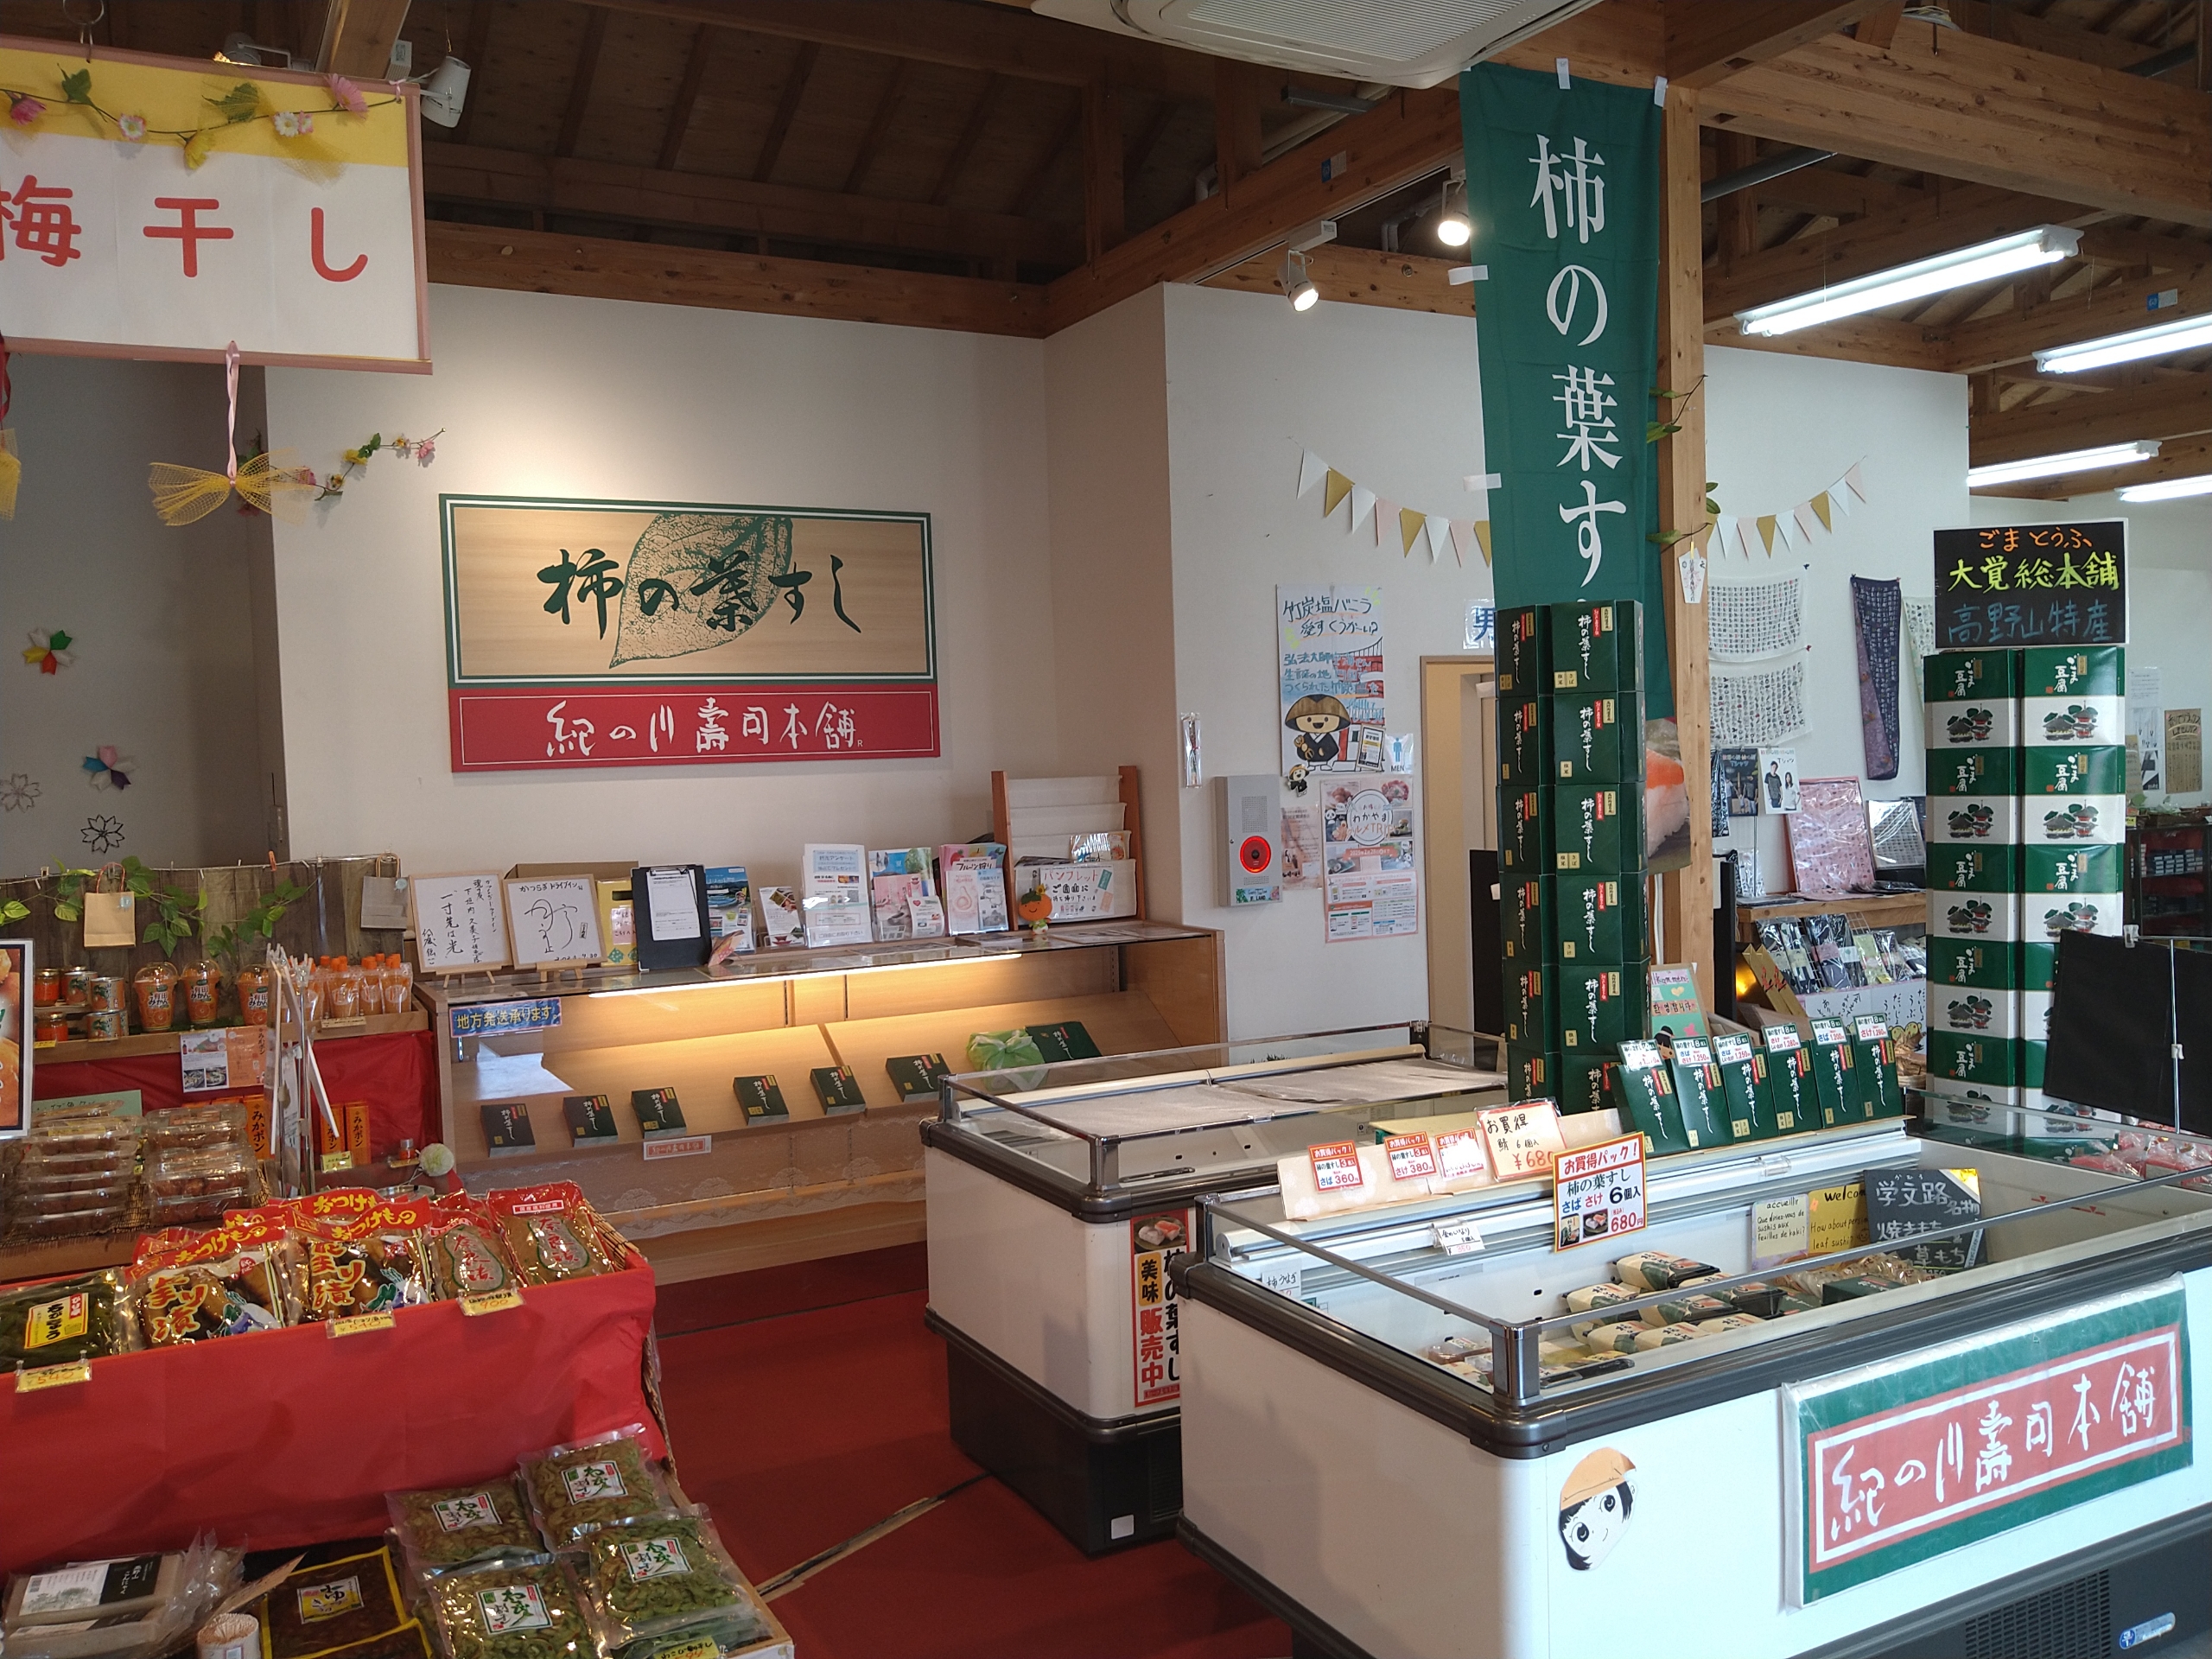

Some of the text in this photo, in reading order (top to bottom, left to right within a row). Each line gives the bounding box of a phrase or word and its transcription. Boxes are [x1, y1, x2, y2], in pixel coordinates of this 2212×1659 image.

[0, 175, 369, 282] 梅干し
[1529, 134, 1630, 603] 柿の葉す
[1979, 526, 2094, 552] ごまとうふ
[1282, 595, 1372, 623] 竹炭塩バニラ
[1948, 599, 2113, 644] 高野山特産
[1353, 812, 1387, 823] わかやま
[1045, 869, 1098, 881] パンフレット
[1523, 1062, 1532, 1103] 柿の葉
[252, 1109, 265, 1153] みかポン
[1487, 1113, 1529, 1135] お買得
[1319, 1174, 1333, 1186] さば
[1395, 1167, 1408, 1177] さけ
[1567, 1168, 1631, 1198] 柿の葉すし
[1562, 1185, 1642, 1214] さば さけ 6個入
[1876, 1180, 1952, 1208] 学文路
[1944, 1199, 1980, 1216] 名物
[1611, 1212, 1643, 1233] 680円
[1810, 1218, 1847, 1231] How about
[1813, 1238, 1829, 1249] leaf
[1913, 1246, 1966, 1267] 草もち
[1141, 1258, 1159, 1303] 美味
[1141, 1306, 1163, 1388] 販売中
